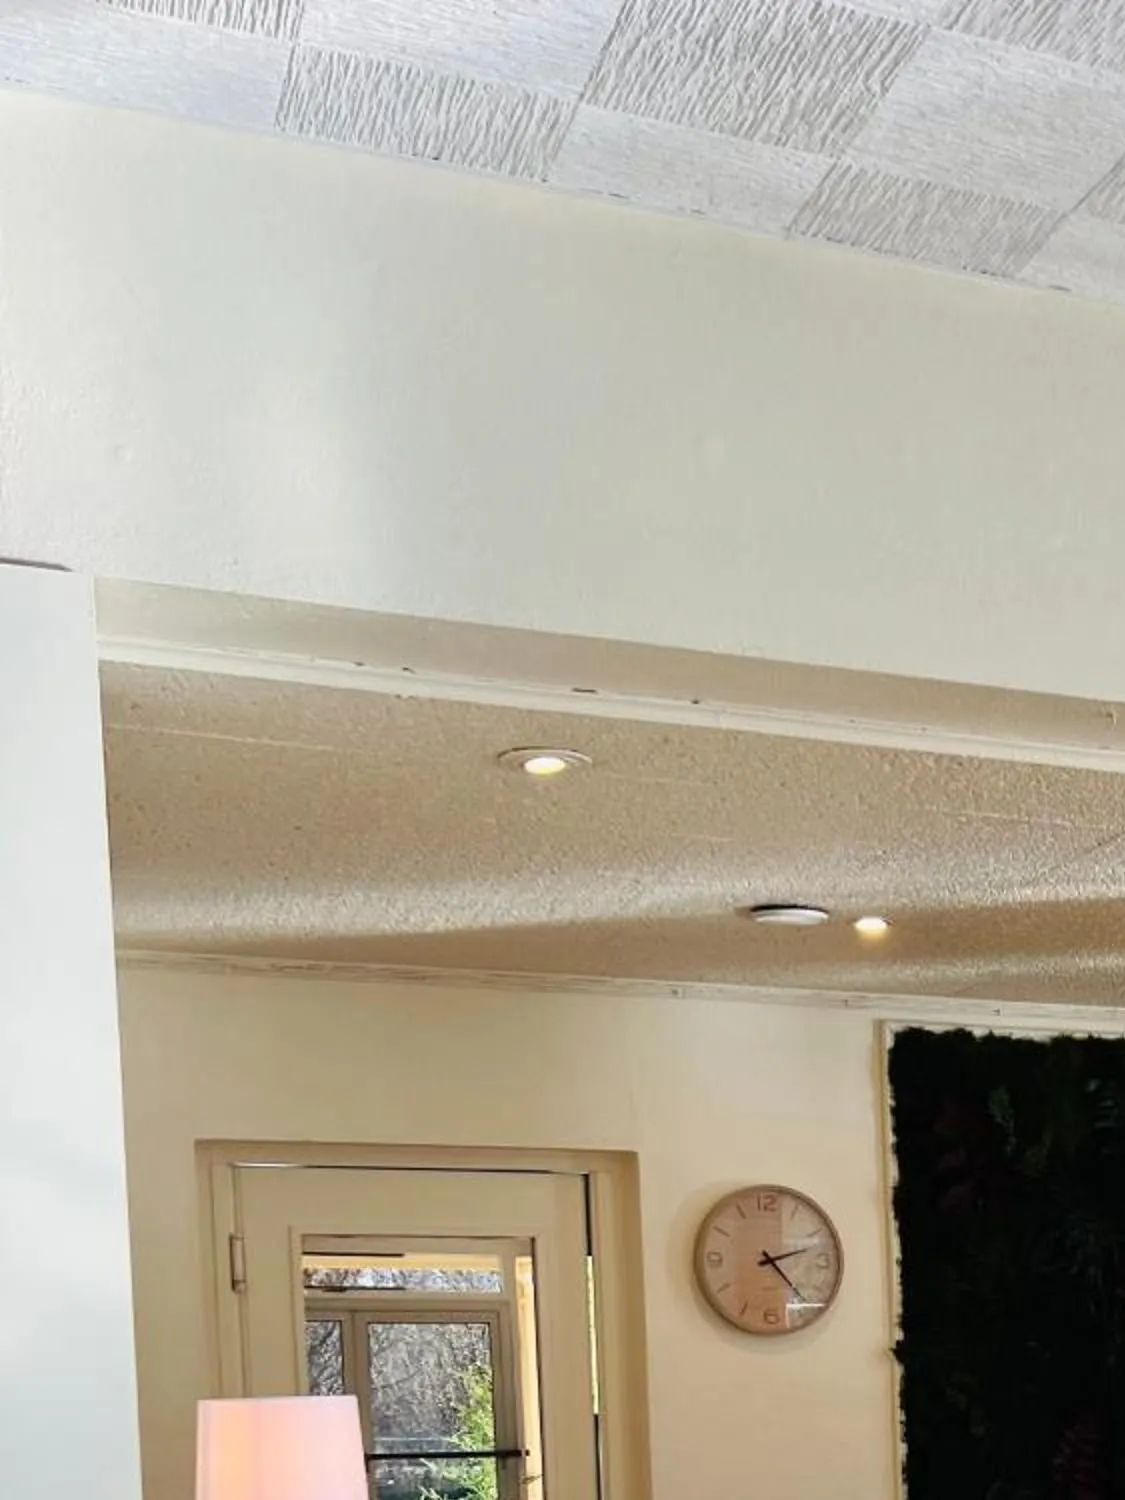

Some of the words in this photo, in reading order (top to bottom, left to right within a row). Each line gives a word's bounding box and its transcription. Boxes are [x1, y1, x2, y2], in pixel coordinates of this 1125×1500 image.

[757, 1194, 777, 1212] 12
[706, 1251, 723, 1268] 9
[815, 1253, 830, 1269] 3
[763, 1309, 780, 1325] 6
